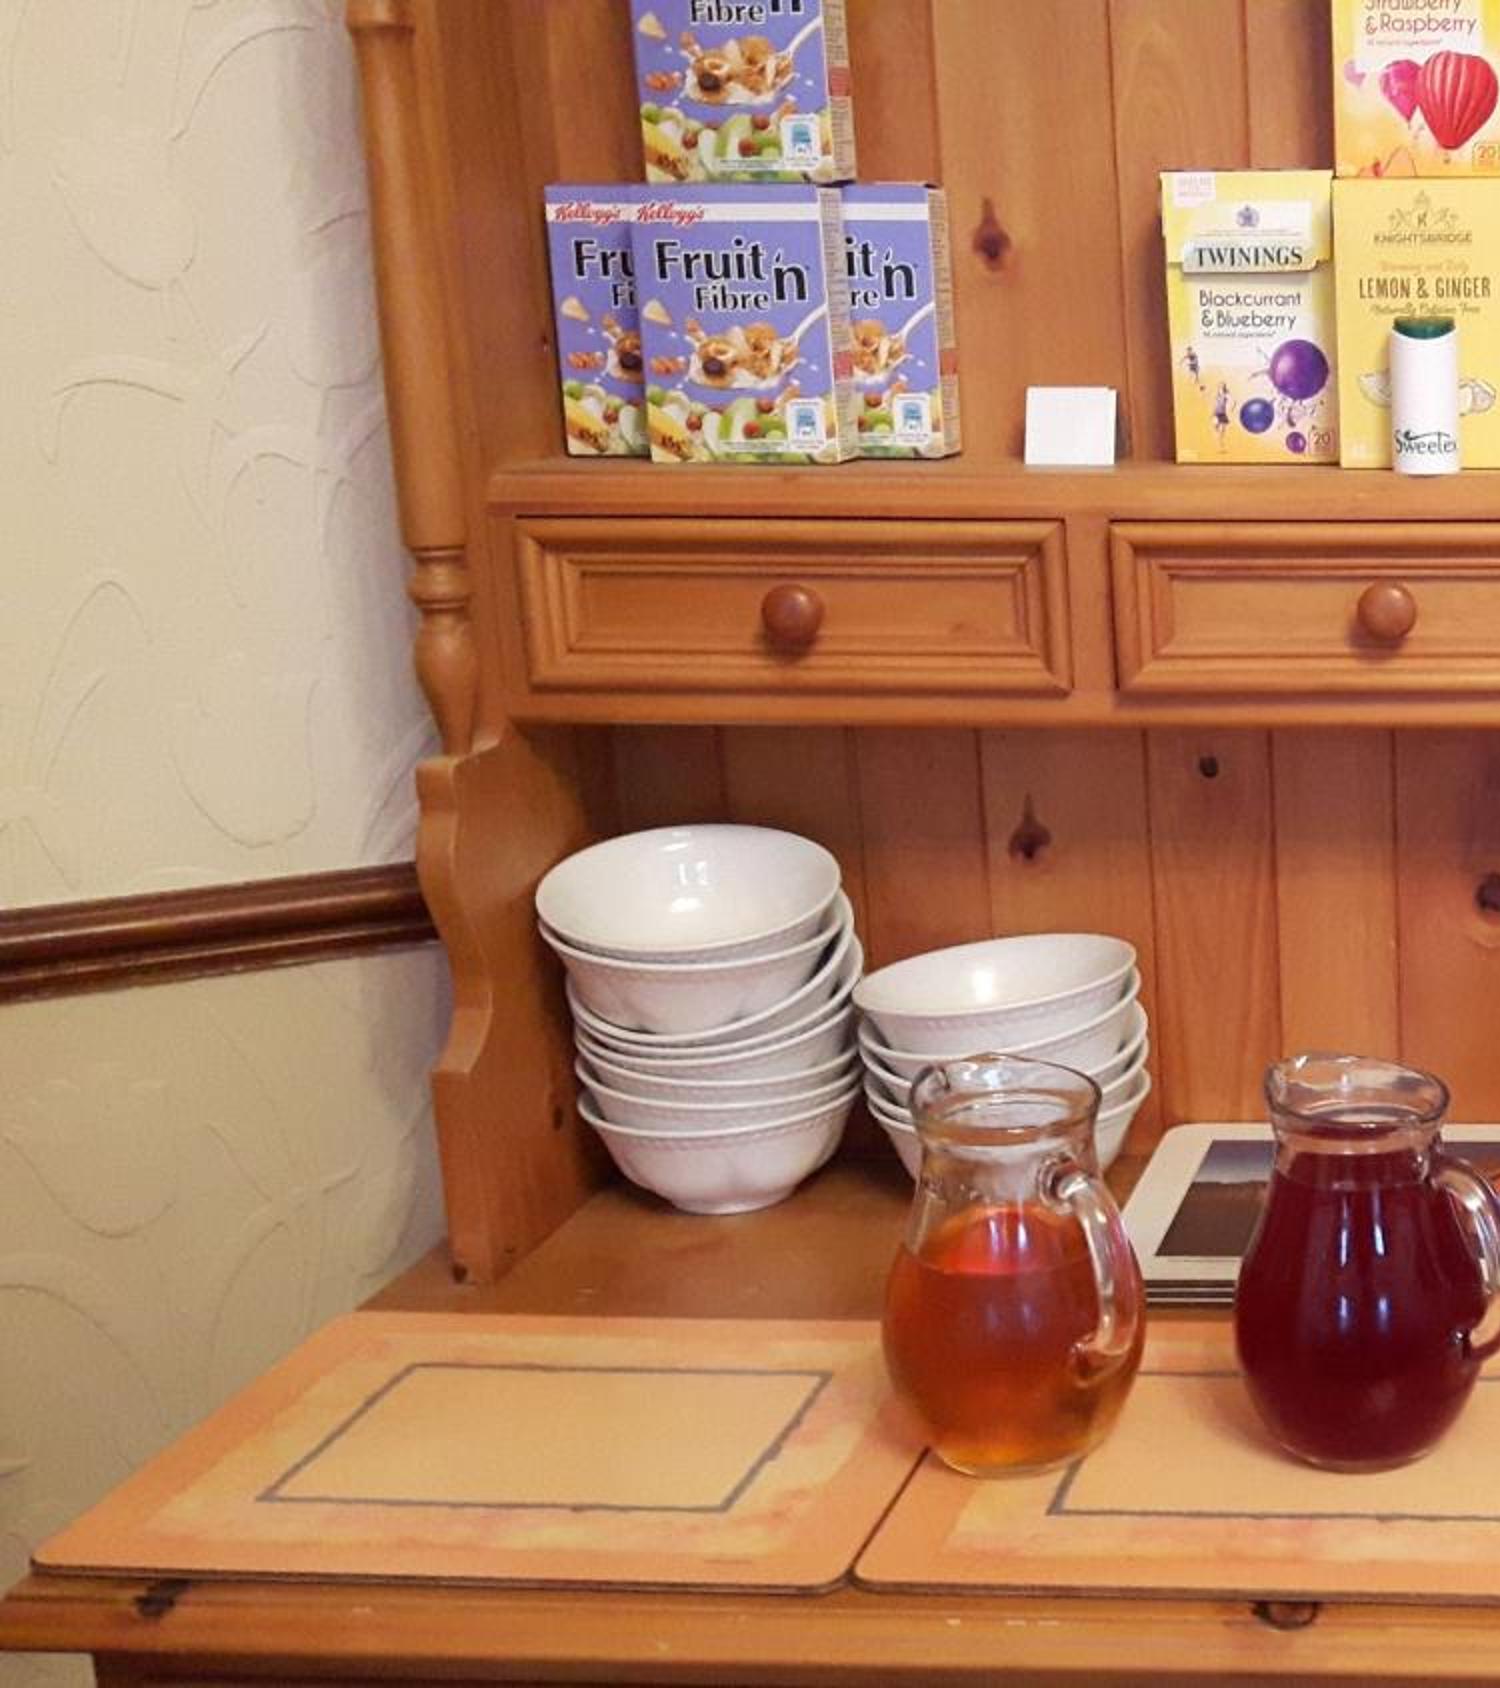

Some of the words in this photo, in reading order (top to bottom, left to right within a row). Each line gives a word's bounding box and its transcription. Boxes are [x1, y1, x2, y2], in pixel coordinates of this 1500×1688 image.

[692, 0, 764, 23] Fibre
[1365, 16, 1378, 35] &
[1380, 12, 1477, 35] Raspberry
[1477, 145, 1497, 160] 20
[555, 202, 621, 225] Kellogg's
[637, 202, 704, 226] Kellogg's
[1373, 232, 1473, 244] KNIGHTSBRIDGE
[655, 238, 766, 280] Fruit
[1195, 246, 1304, 267] TWININGS
[695, 285, 769, 311] Fibre
[1199, 289, 1302, 307] Blackcurrant
[1358, 276, 1411, 299] LEMON
[1416, 277, 1430, 299] &
[1435, 275, 1491, 299] GINGER
[1201, 309, 1214, 328] &
[1216, 309, 1297, 331] Blueberry
[1313, 431, 1331, 445] 20
